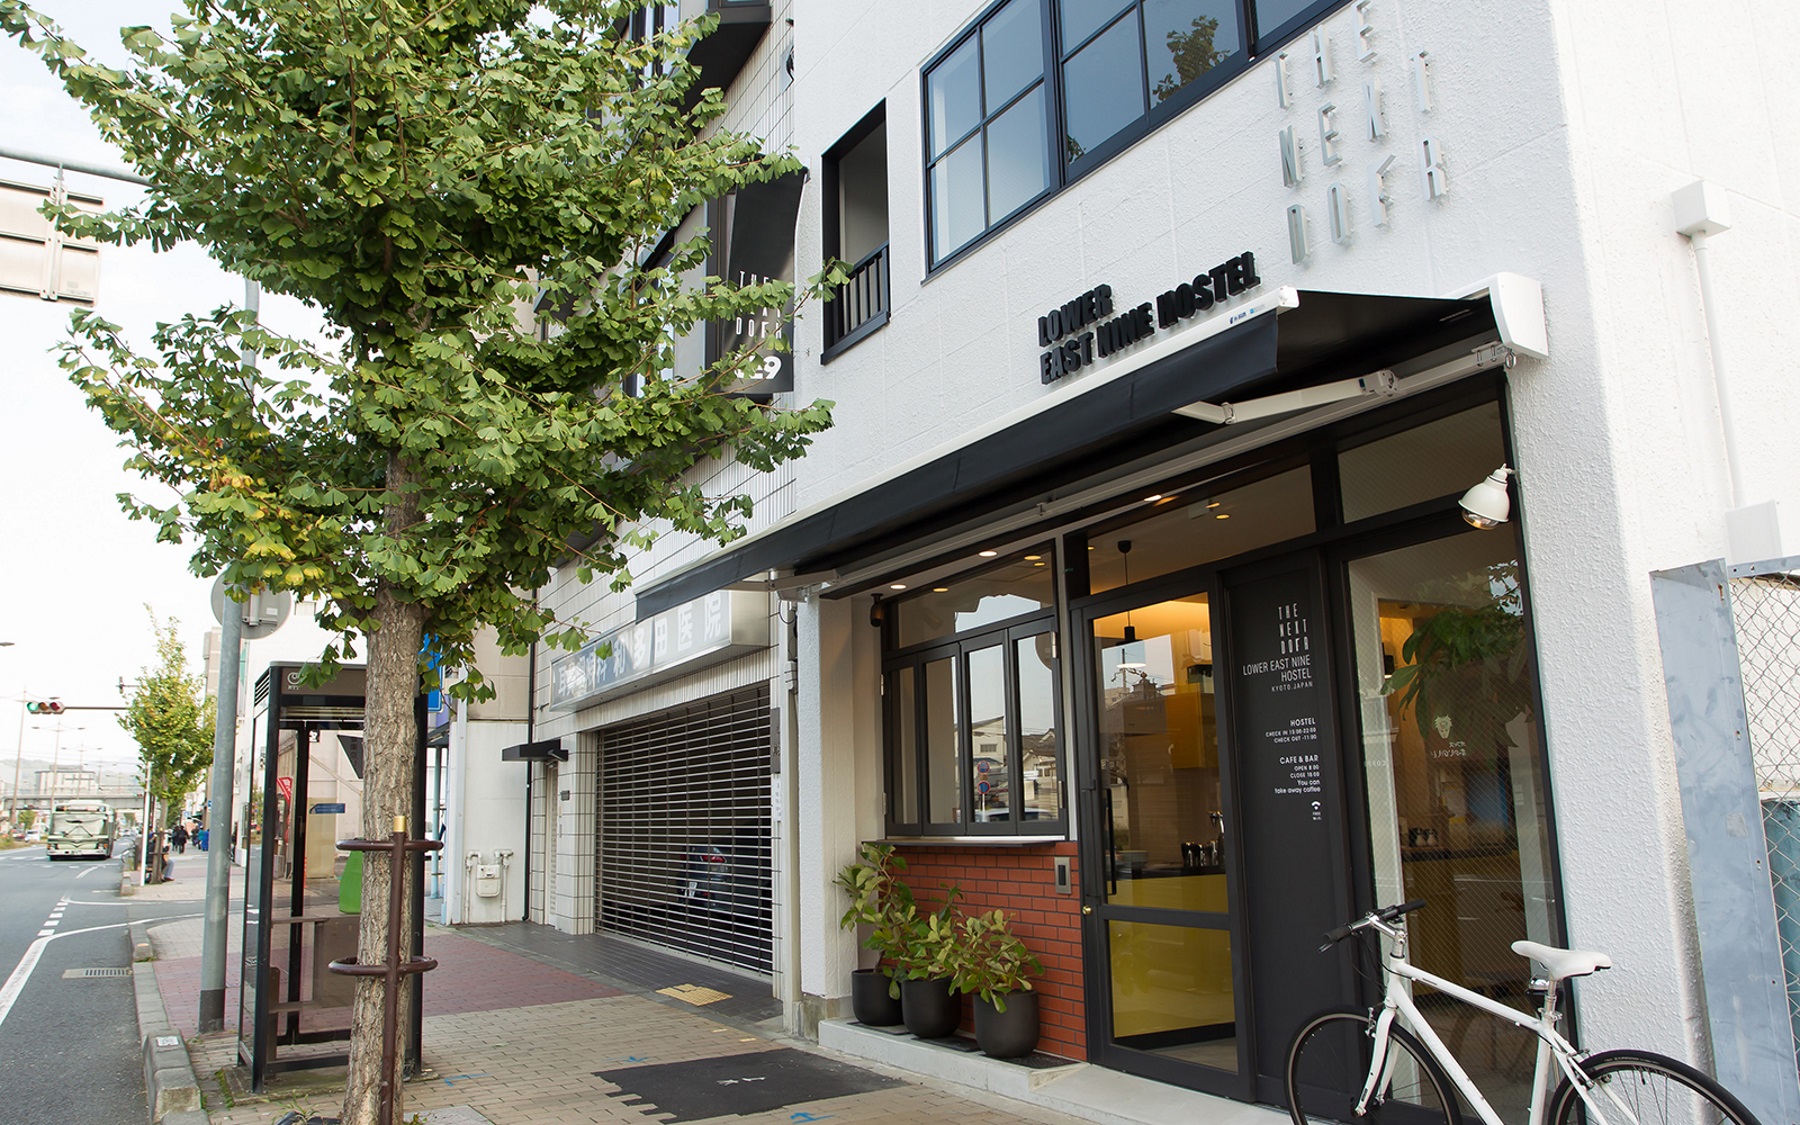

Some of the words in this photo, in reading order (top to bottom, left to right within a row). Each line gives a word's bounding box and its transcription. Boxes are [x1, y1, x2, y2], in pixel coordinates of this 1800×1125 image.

[1270, 0, 1378, 110] THE
[1038, 283, 1114, 347] LOWER
[1039, 331, 1094, 385] EAST
[1096, 301, 1155, 359] NINE
[1156, 250, 1261, 330] HOSTEL
[1278, 603, 1298, 620] THE
[1279, 619, 1307, 638] NEXT
[1242, 661, 1269, 676] LOWER
[1270, 657, 1290, 672] EAST
[1291, 654, 1311, 668] NINE
[1281, 667, 1312, 682] HOSTEL
[1289, 717, 1316, 727] HOSTEL
[1265, 730, 1281, 738] CHECK
[1279, 755, 1297, 765] CAFE
[1298, 755, 1303, 763] &
[1304, 754, 1319, 763] BAR
